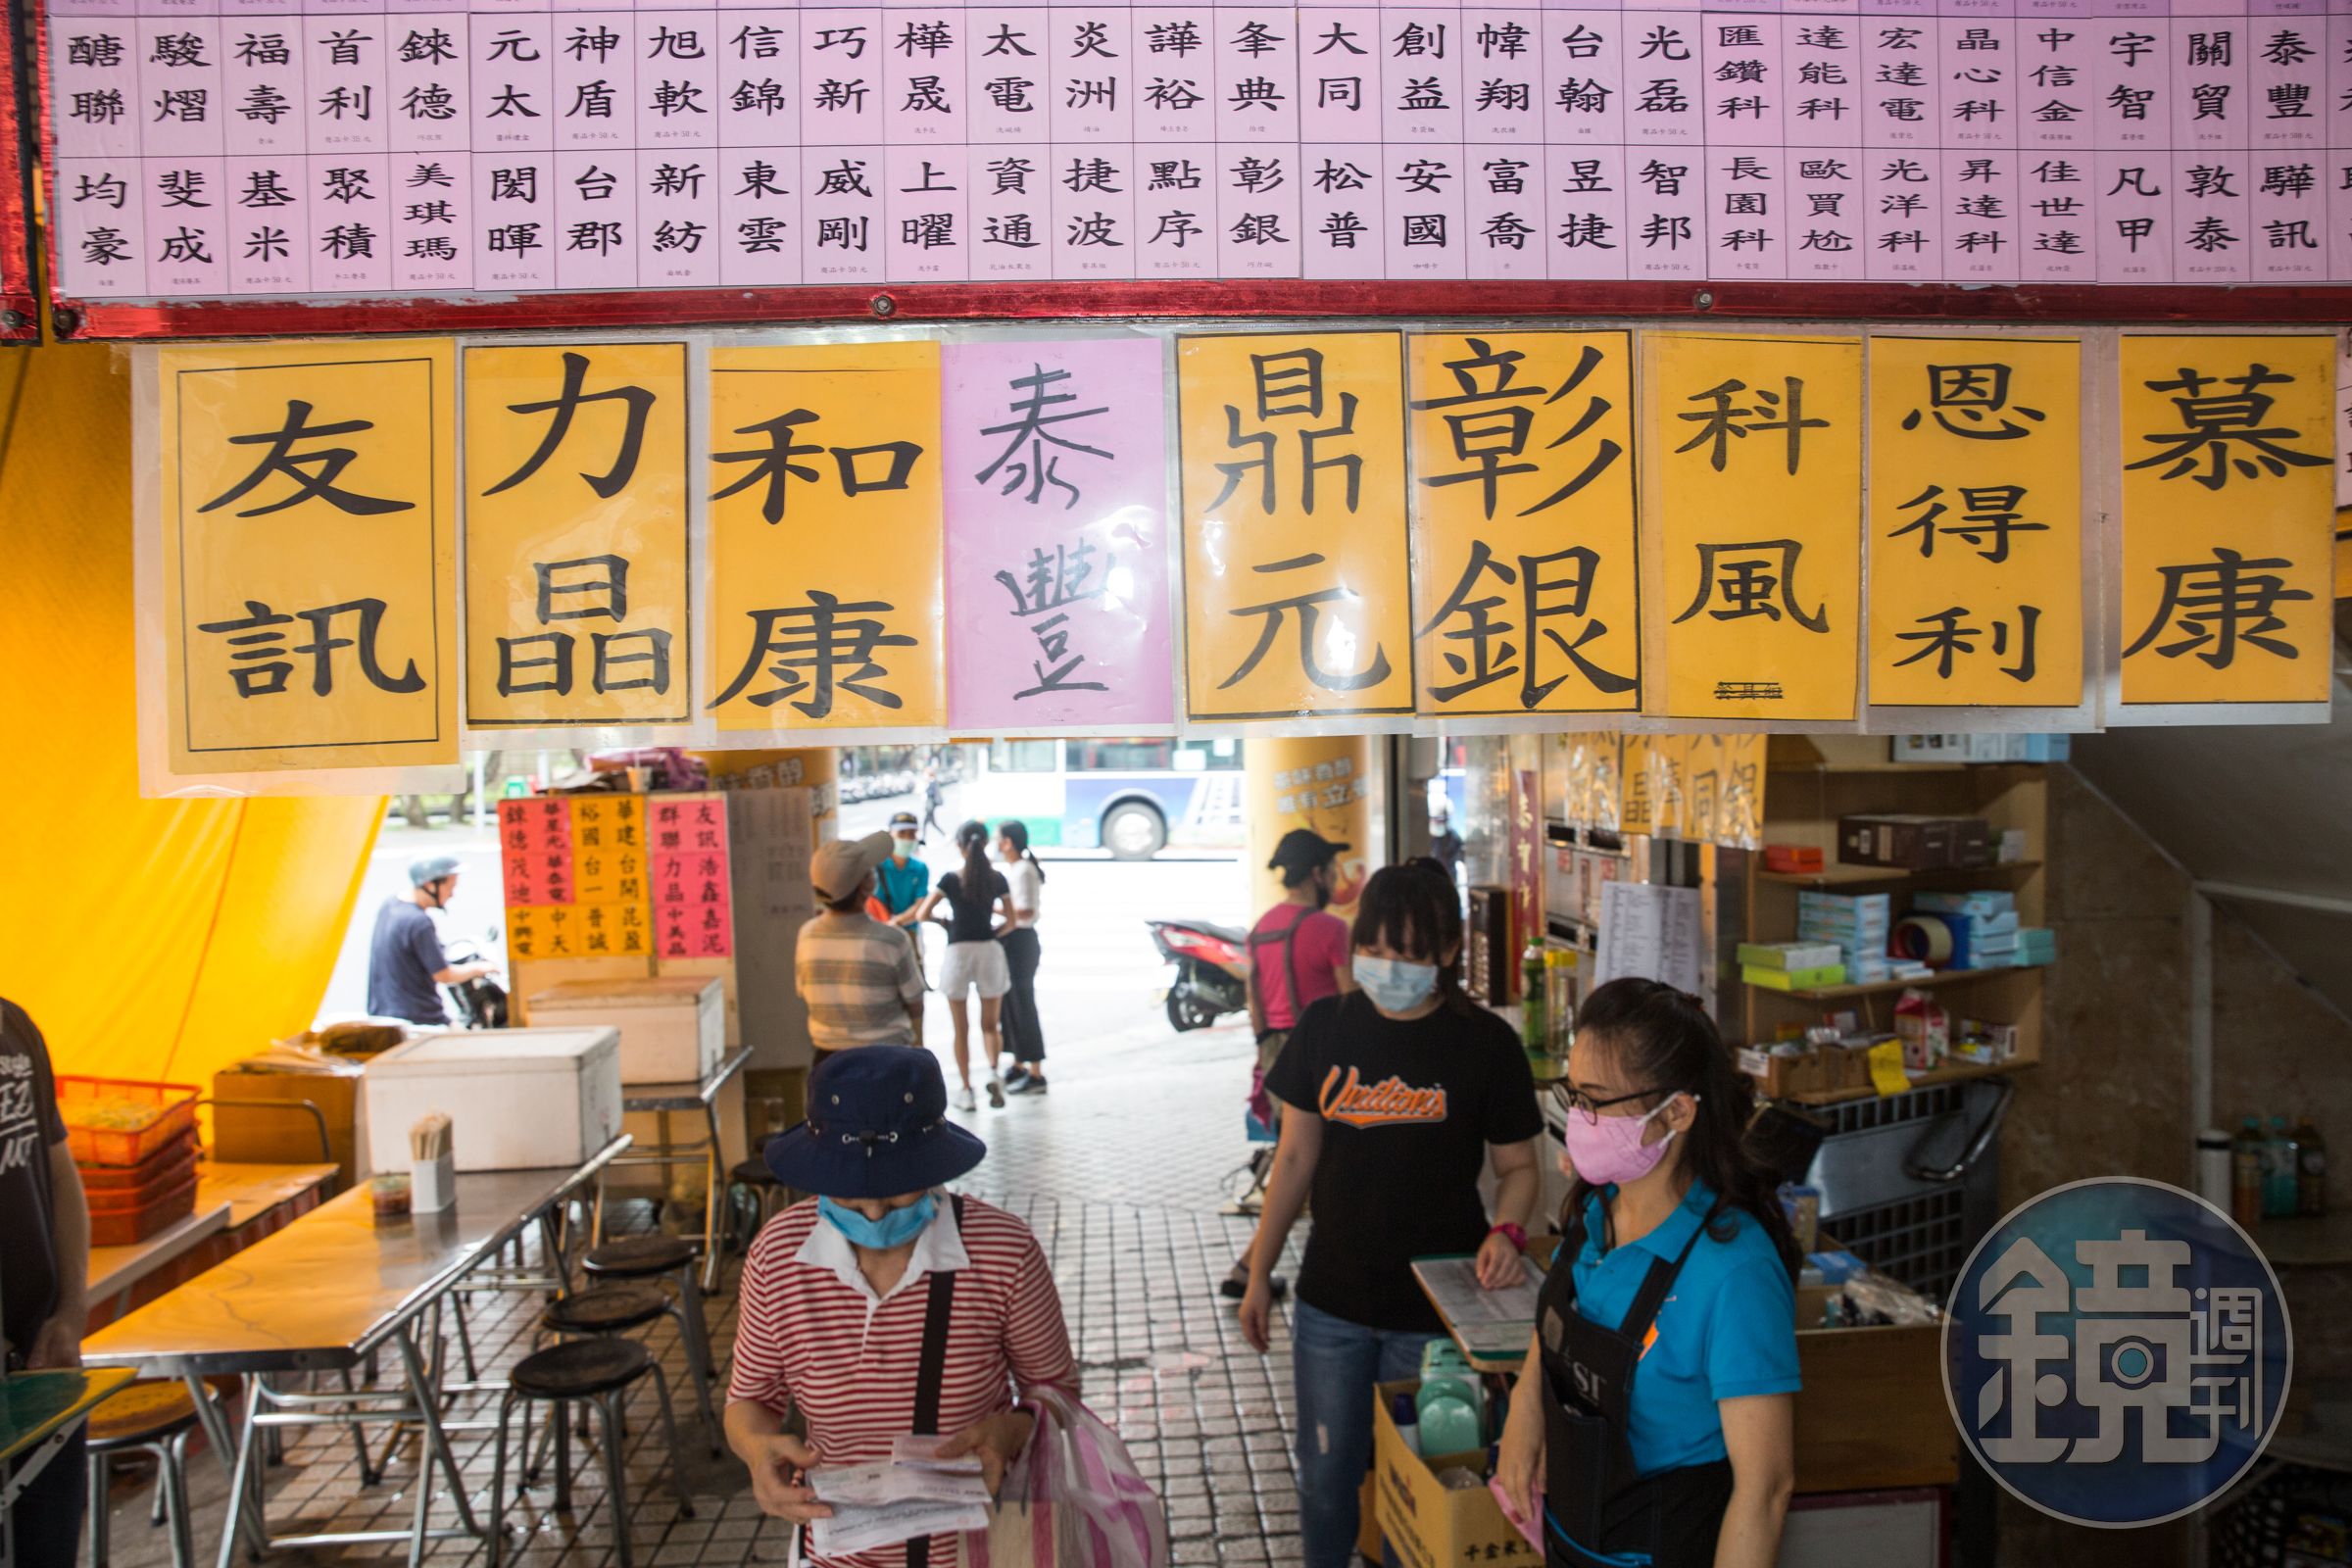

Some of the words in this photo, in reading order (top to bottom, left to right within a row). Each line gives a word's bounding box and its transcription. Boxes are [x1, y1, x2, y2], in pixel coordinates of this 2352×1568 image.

[68, 33, 125, 125] 醣聯
[148, 31, 213, 122] 駿熠
[233, 32, 292, 125] 福壽
[318, 28, 373, 122] 首利
[397, 27, 460, 121] 錸德
[485, 29, 542, 119] 元太
[564, 24, 621, 119] 神盾
[647, 25, 709, 118] 旭軟
[728, 24, 786, 118] 信錦
[812, 25, 871, 115] 巧新
[893, 20, 955, 114] 樺晟
[981, 23, 1038, 113] 太電
[1065, 21, 1119, 112] 炎洲
[1312, 22, 1369, 112] 大同
[1392, 22, 1450, 111] 創益
[1474, 21, 1531, 112] 幃翔
[1554, 23, 1615, 115] 台翰
[1634, 24, 1691, 114] 光磊
[1713, 24, 1771, 120] 匯鑽科
[1794, 24, 1850, 122] 達能科
[1875, 26, 1928, 122] 宏達電
[1952, 27, 2006, 123] 晶心科
[2028, 27, 2083, 122] 中信金
[2106, 31, 2156, 121] 宇智
[2187, 30, 2232, 121] 關貿
[2259, 29, 2317, 120] 泰豐
[72, 172, 134, 267] 均豪
[157, 169, 214, 265] 斐成
[237, 170, 297, 263] 基米
[319, 167, 377, 260] 聚積
[402, 162, 459, 262] 美琪瑪
[565, 164, 623, 258] 台郡
[649, 163, 708, 254] 新紡
[733, 159, 791, 254] 東雲
[813, 159, 873, 253] 威剛
[900, 161, 958, 251] 上曜
[981, 156, 1042, 249] 資通
[1061, 157, 1125, 247] 捷波
[1147, 159, 1203, 249] 點序
[1228, 156, 1291, 246] 彰銀
[1312, 158, 1373, 250] 松普
[1395, 158, 1452, 249] 安國
[1479, 158, 1537, 251] 富喬
[1556, 159, 1618, 250] 昱捷
[1638, 159, 1691, 251] 智邦
[1719, 156, 1775, 253] 長園科
[1877, 158, 1931, 254] 光洋科
[1954, 159, 2008, 255] 昇達科
[2030, 160, 2085, 255] 佳世達
[2106, 167, 2162, 254] 凡甲
[2184, 164, 2240, 253] 敦泰
[2259, 163, 2319, 249] 驊訊
[197, 399, 427, 699] 友訊
[480, 352, 674, 698] 力晶
[1203, 347, 1392, 692] 鼎元
[1408, 338, 1642, 709] 彰銀
[1672, 376, 1832, 634] 科風
[1886, 363, 2051, 683] 恩得利
[2120, 363, 2336, 671] 慕康
[706, 408, 924, 718] 和康
[695, 805, 718, 849] 友訊
[584, 857, 603, 893] 台一
[664, 858, 683, 902] 力晶
